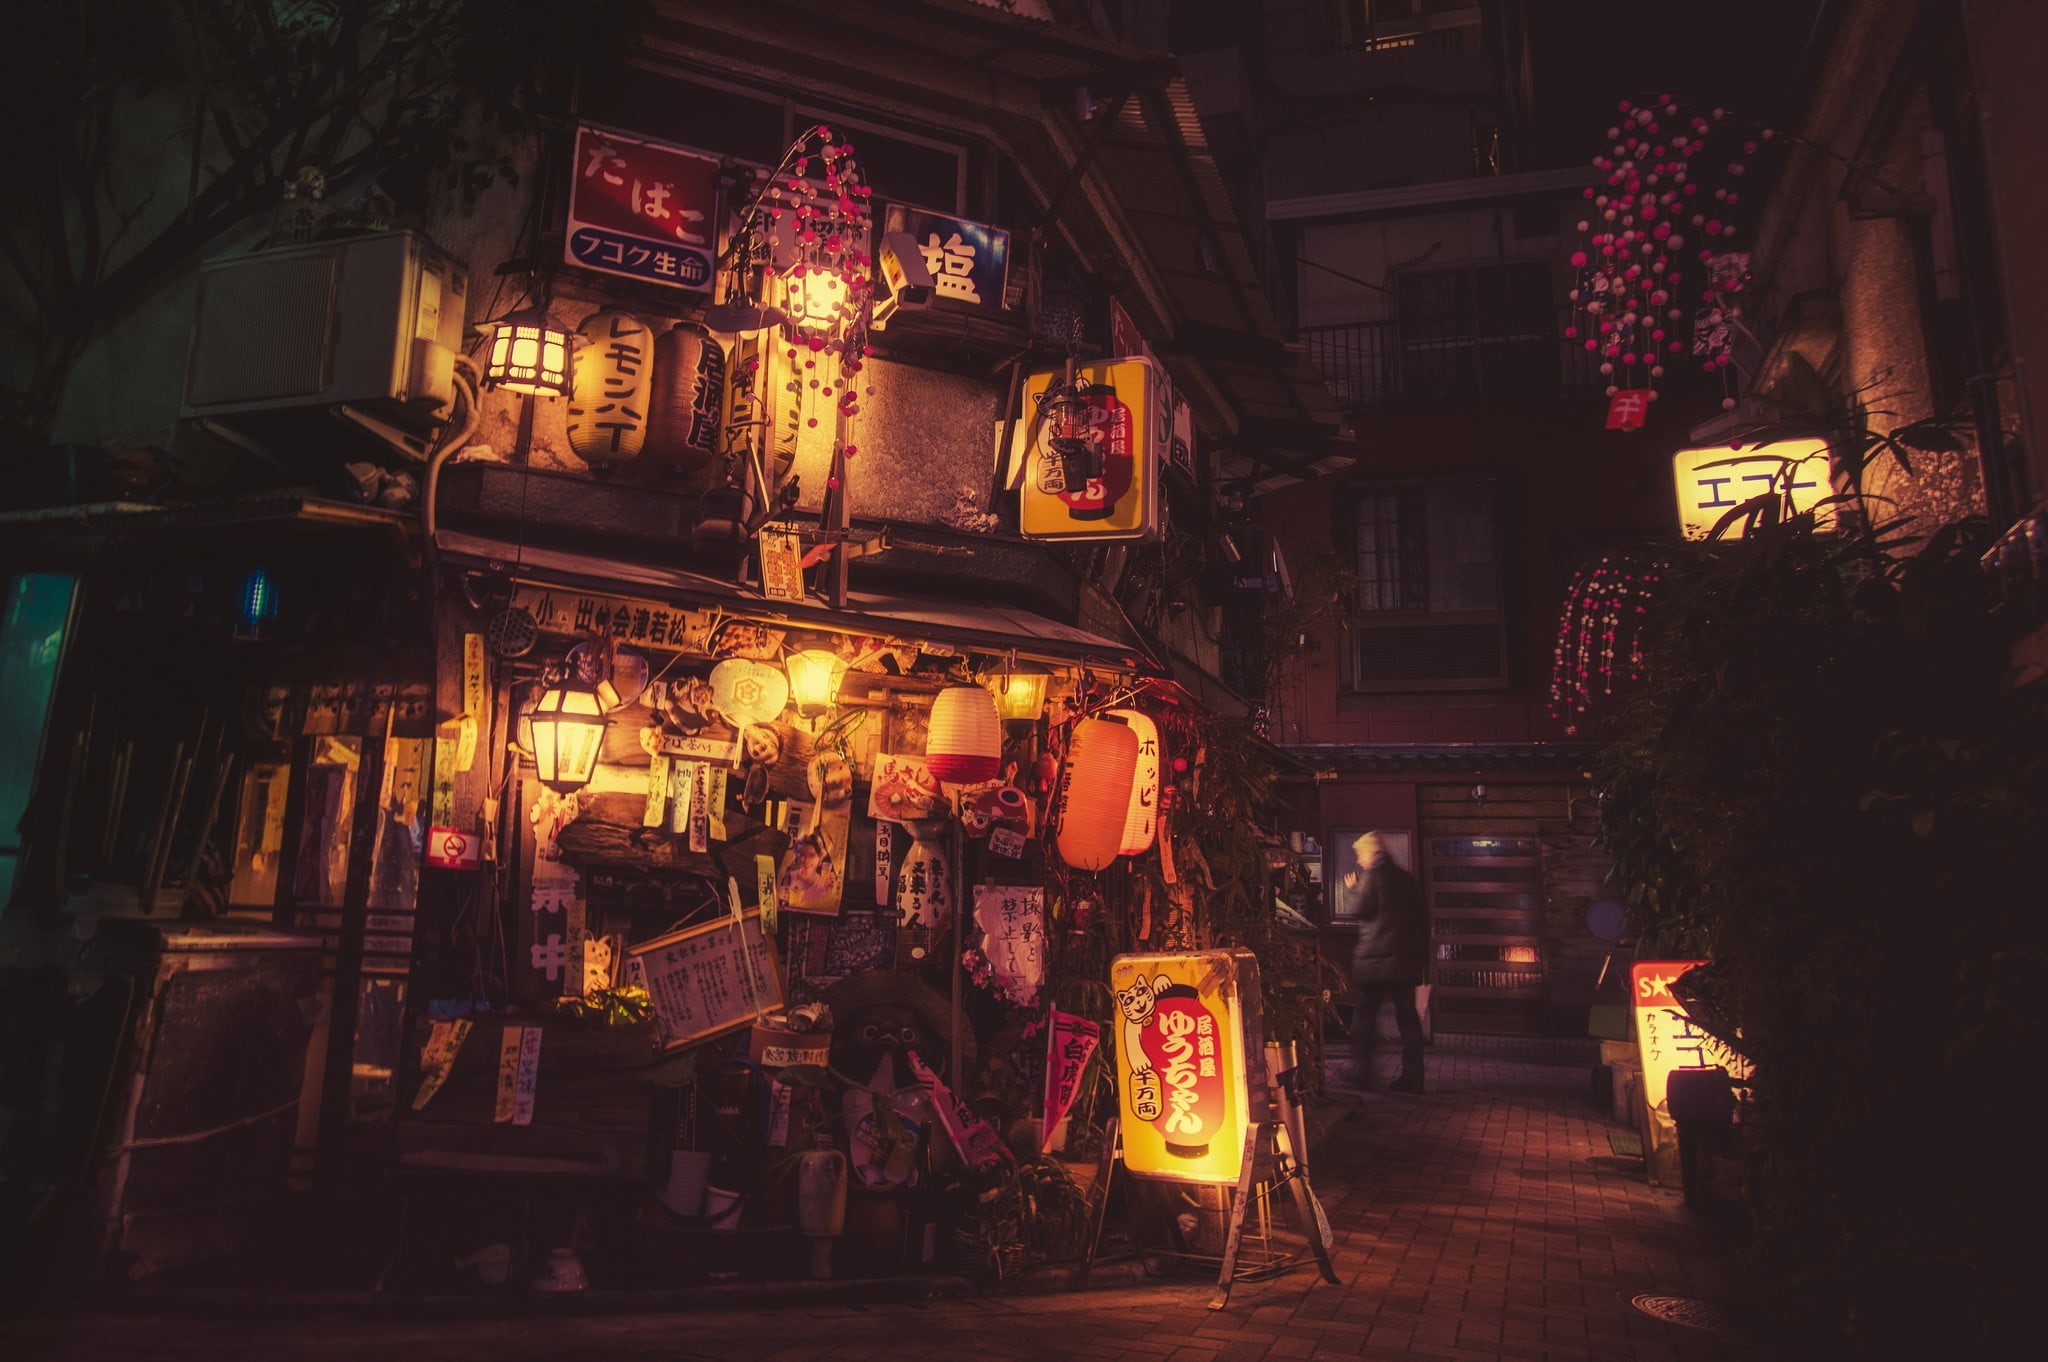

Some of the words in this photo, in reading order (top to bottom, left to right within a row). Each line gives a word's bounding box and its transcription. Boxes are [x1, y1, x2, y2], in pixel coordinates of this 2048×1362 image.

[584, 145, 705, 245] たばこ
[578, 233, 705, 281] フコク生命
[917, 233, 981, 304] 塩
[1111, 407, 1126, 455] 居酒屋
[1138, 737, 1156, 835] ホッピー
[1197, 1016, 1216, 1077] 居酒屋
[1646, 1012, 1662, 1061] カラオケ
[1158, 1009, 1203, 1134] ゆうちゃん
